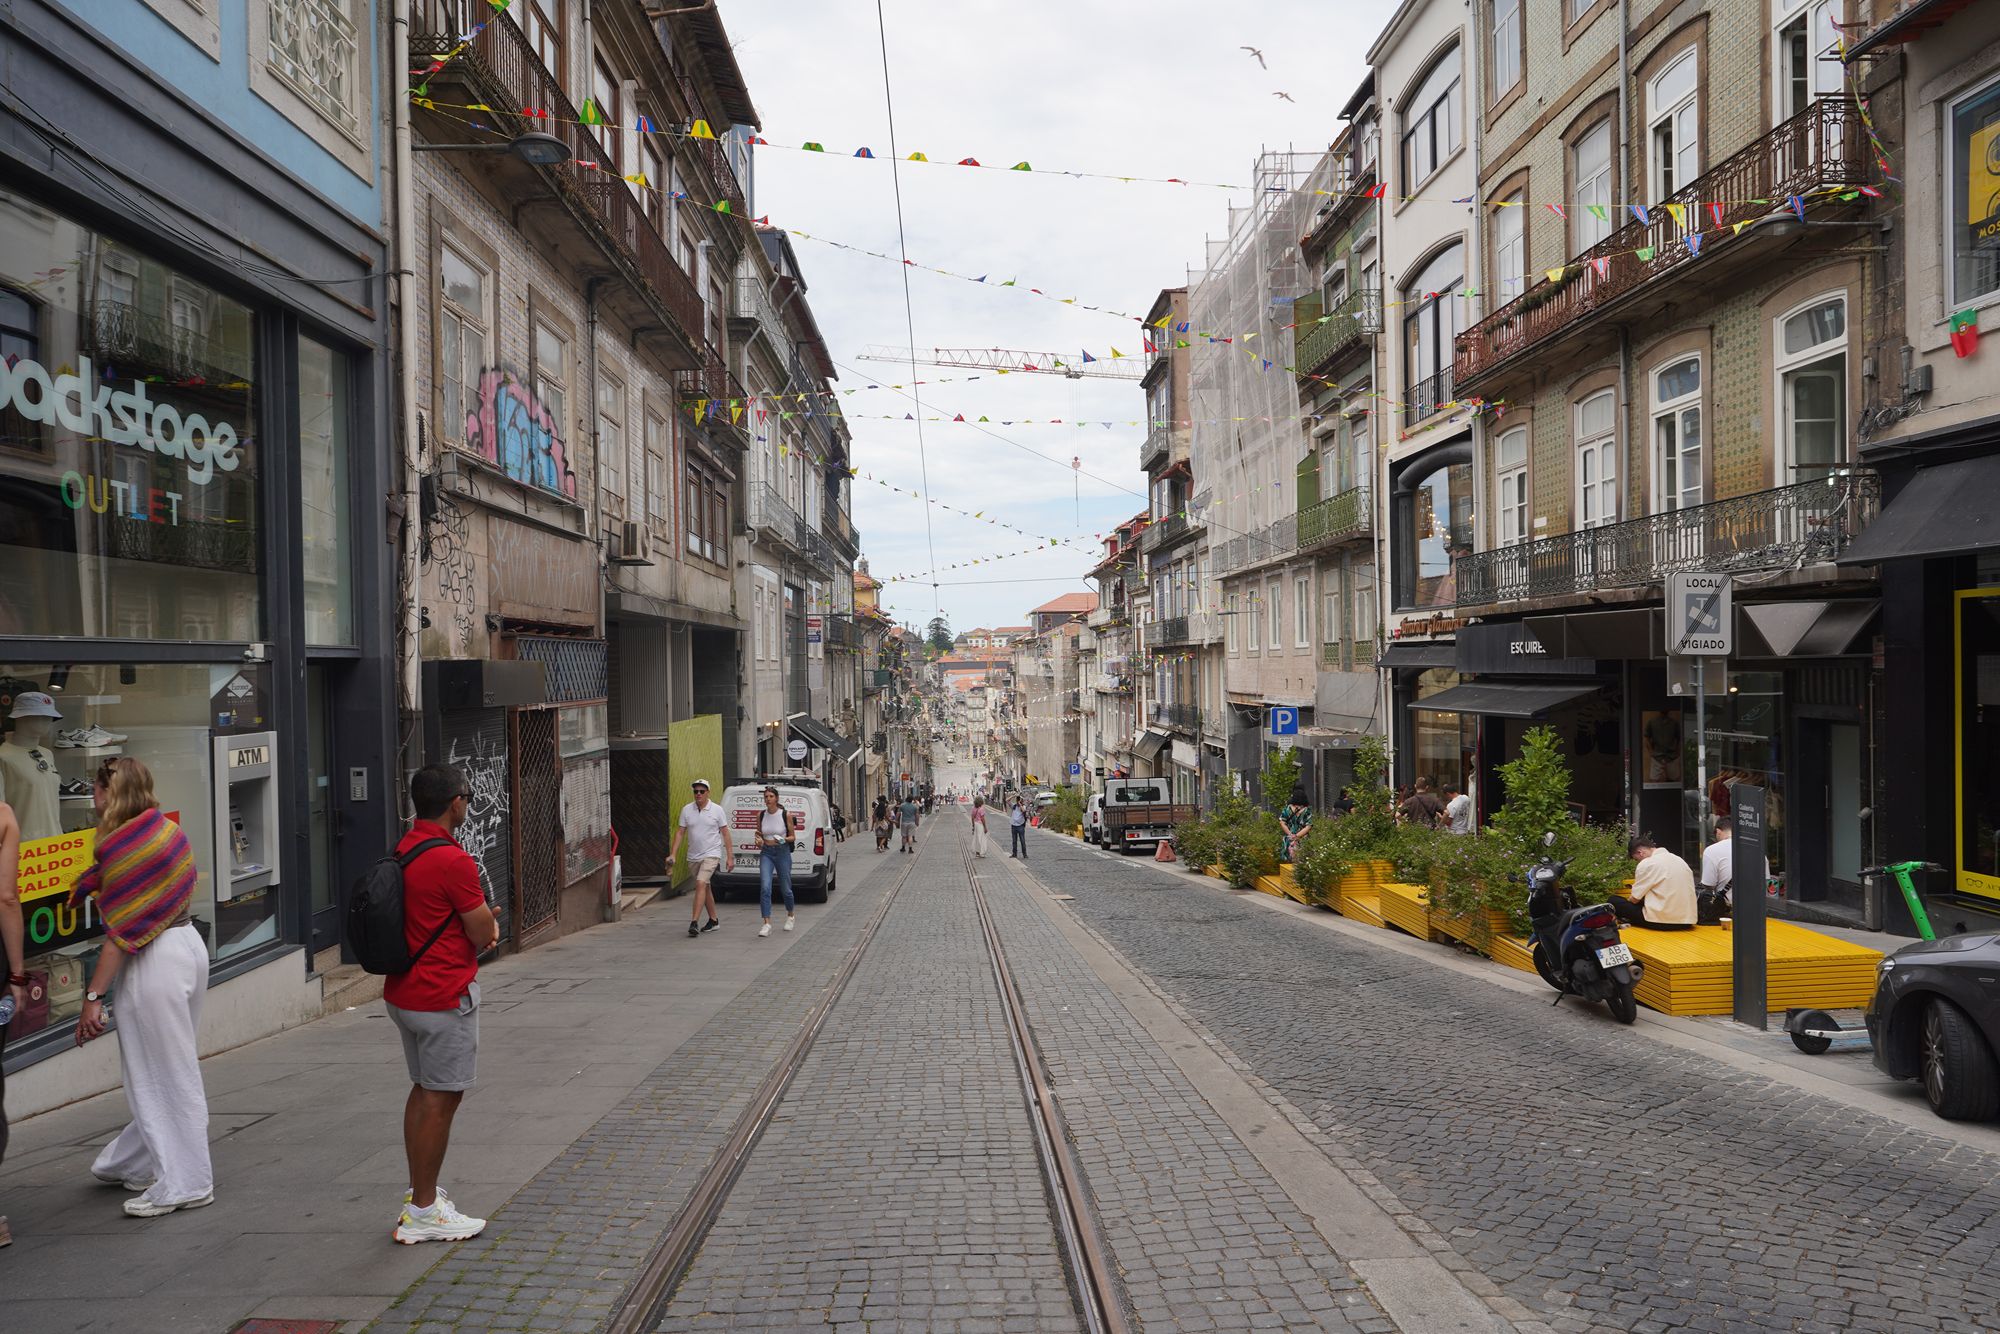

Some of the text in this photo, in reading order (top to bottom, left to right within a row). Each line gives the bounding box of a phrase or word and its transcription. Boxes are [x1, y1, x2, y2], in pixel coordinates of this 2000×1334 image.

[61, 471, 182, 526] OUTLET
[1686, 579, 1720, 588] LOCAL
[1681, 639, 1725, 649] VIGIADO
[1277, 710, 1293, 733] P
[237, 747, 263, 766] ATM
[1071, 764, 1079, 774] P
[1608, 945, 1621, 956] AB
[1605, 953, 1629, 966] 43RG
